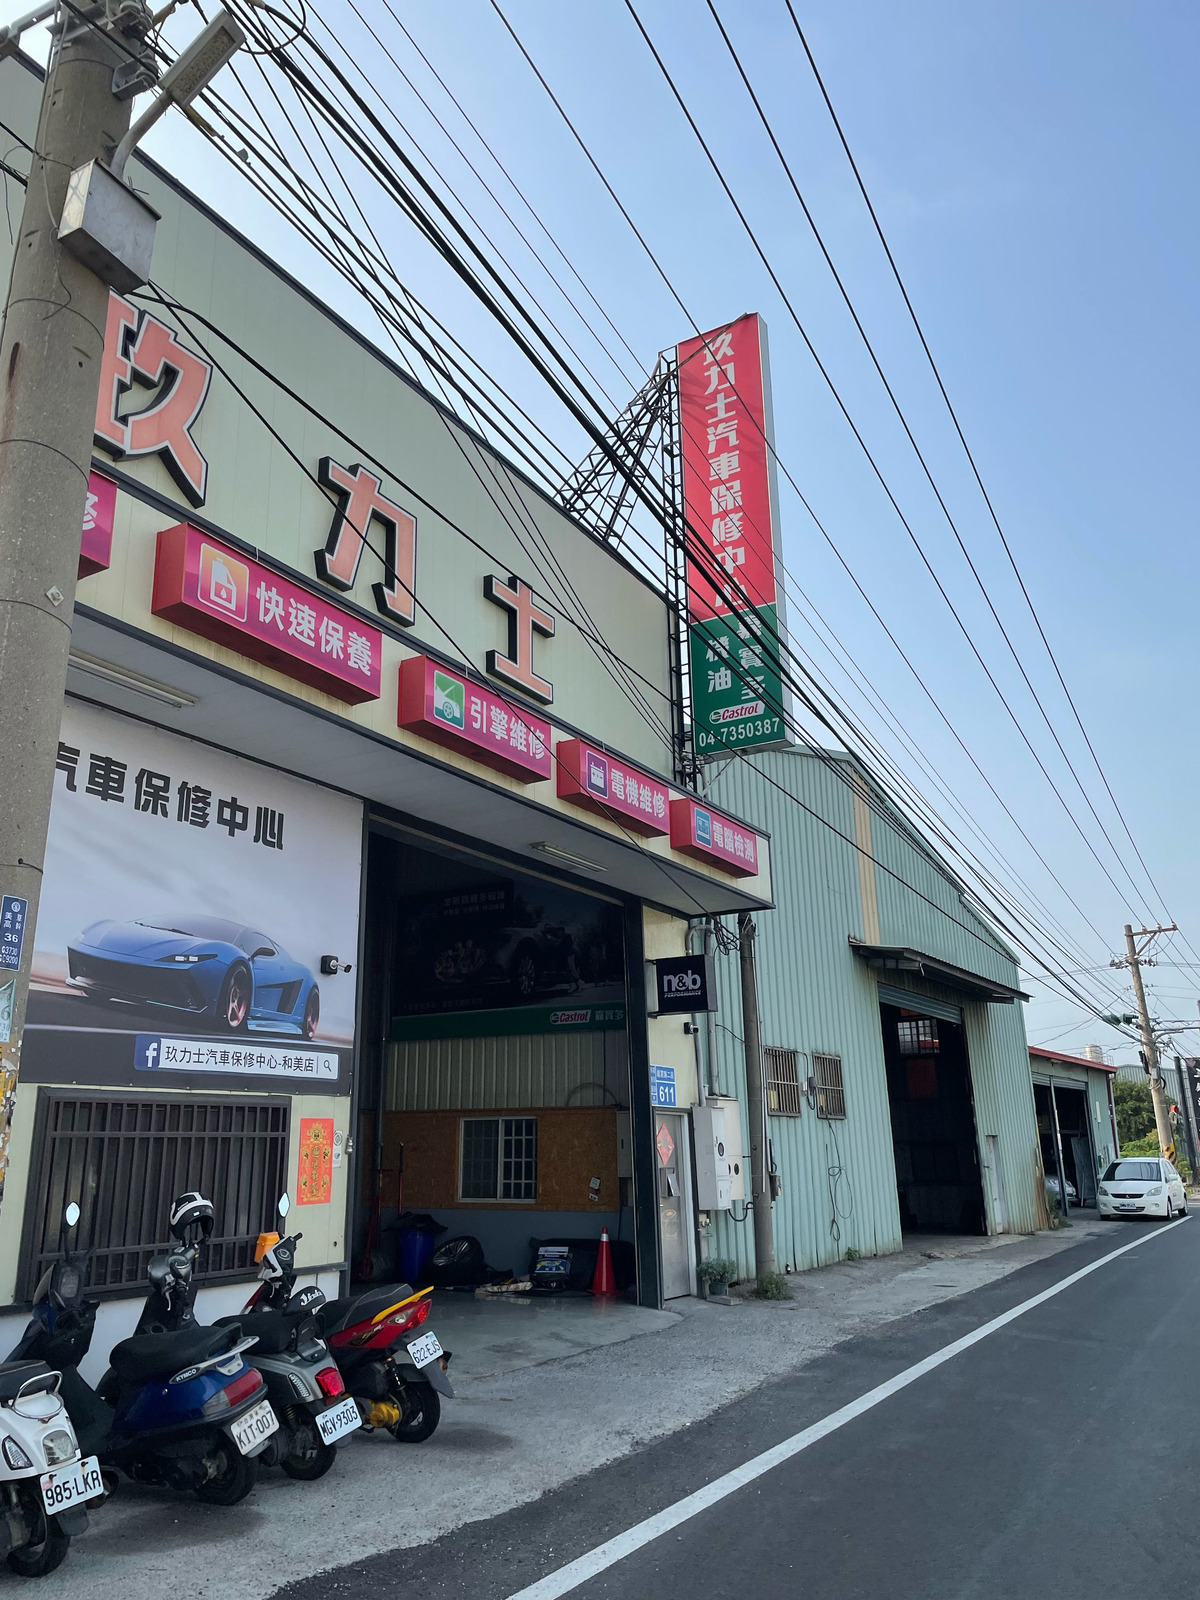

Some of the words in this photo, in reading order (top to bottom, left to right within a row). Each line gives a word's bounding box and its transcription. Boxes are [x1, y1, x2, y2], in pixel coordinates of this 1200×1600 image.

[702, 331, 748, 608] 玖力士汽車保修中心
[256, 581, 373, 678] 快速保養
[705, 635, 732, 693] 機油
[722, 703, 759, 721] Castrol
[470, 696, 546, 760] 引擎維修
[699, 718, 780, 747] 04-7350387
[55, 741, 285, 851] 汽車保修中心
[610, 768, 666, 819] 電機維修
[4, 932, 19, 943] 36
[663, 969, 701, 992] n&b
[559, 1011, 589, 1023] Castrol
[165, 1045, 315, 1072] 玖力士汽車保修中心-和美店
[659, 1085, 675, 1103] 611
[176, 1368, 197, 1382] KYMCO
